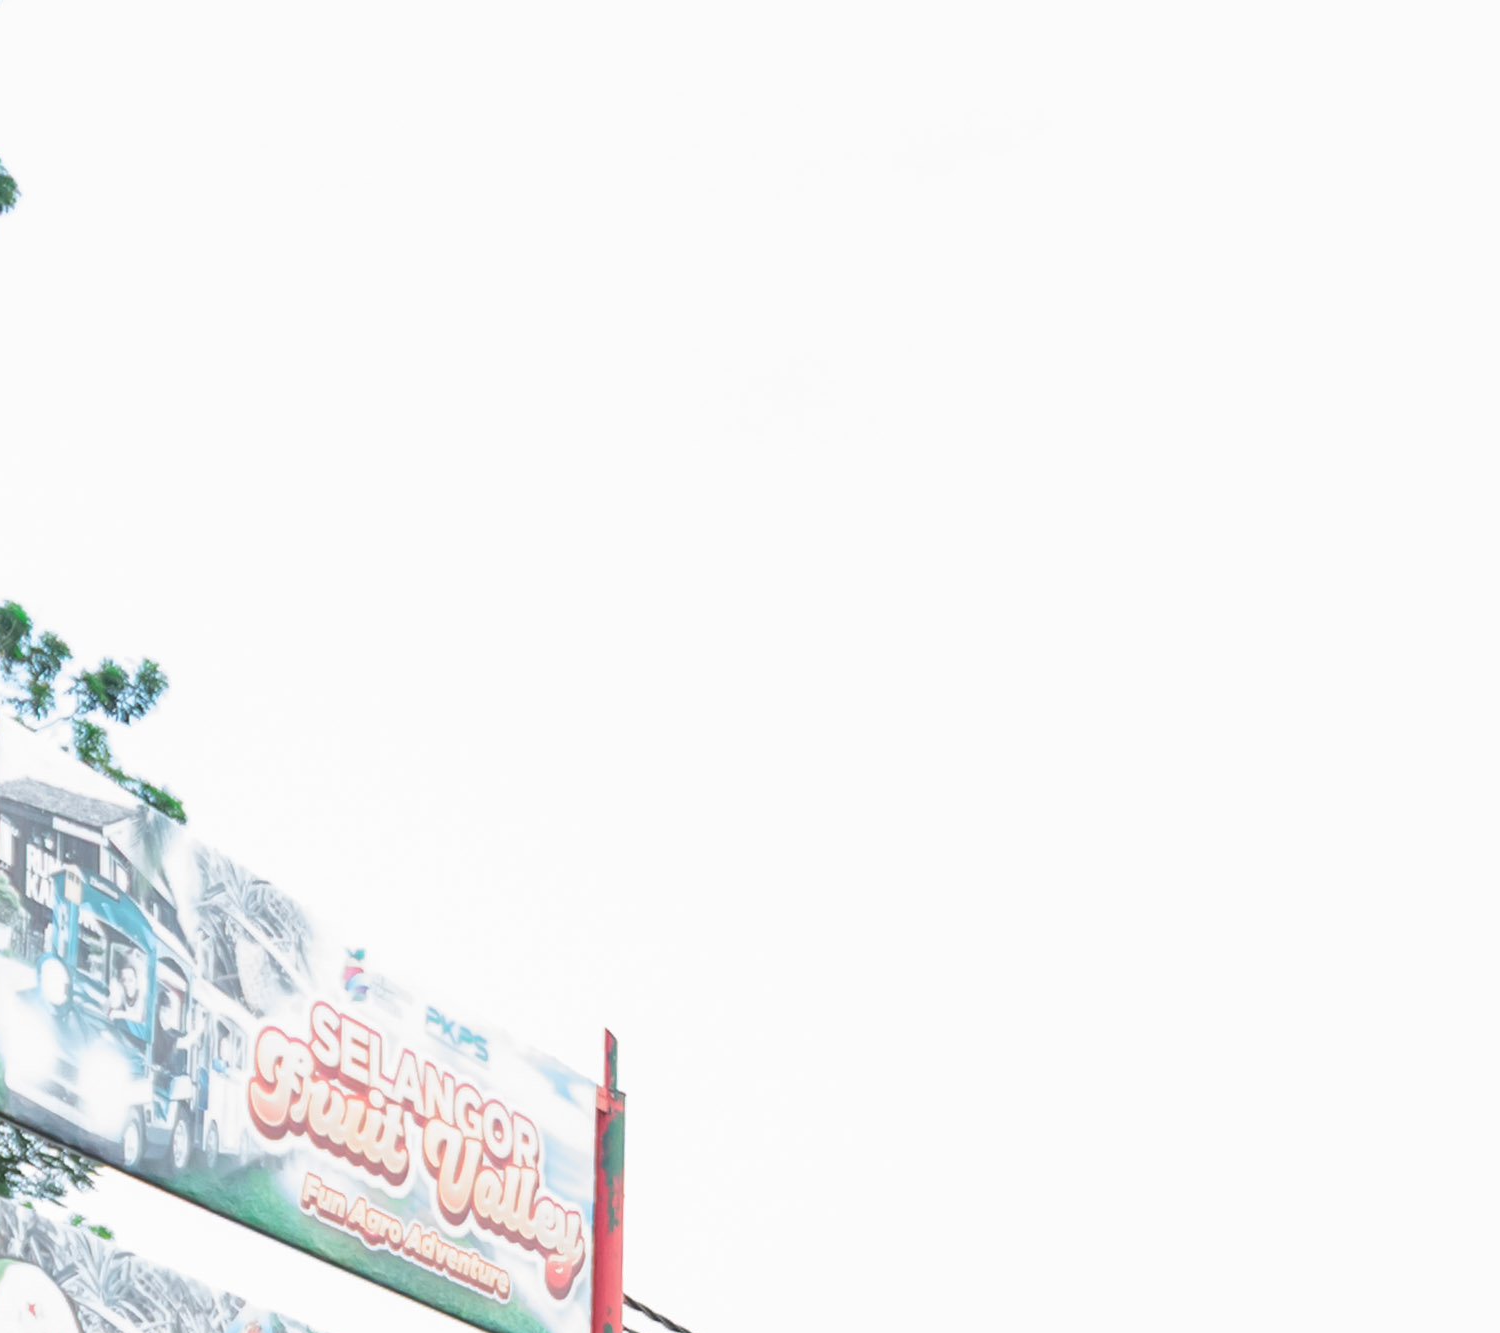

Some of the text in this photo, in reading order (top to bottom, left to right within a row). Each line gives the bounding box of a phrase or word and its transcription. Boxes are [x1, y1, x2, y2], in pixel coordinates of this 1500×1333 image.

[310, 1001, 540, 1168] SELANGOR
[426, 1006, 488, 1062] PKPS
[250, 1026, 585, 1300] Fruit Valley
[303, 1173, 511, 1294] Fun Agro Adventure
